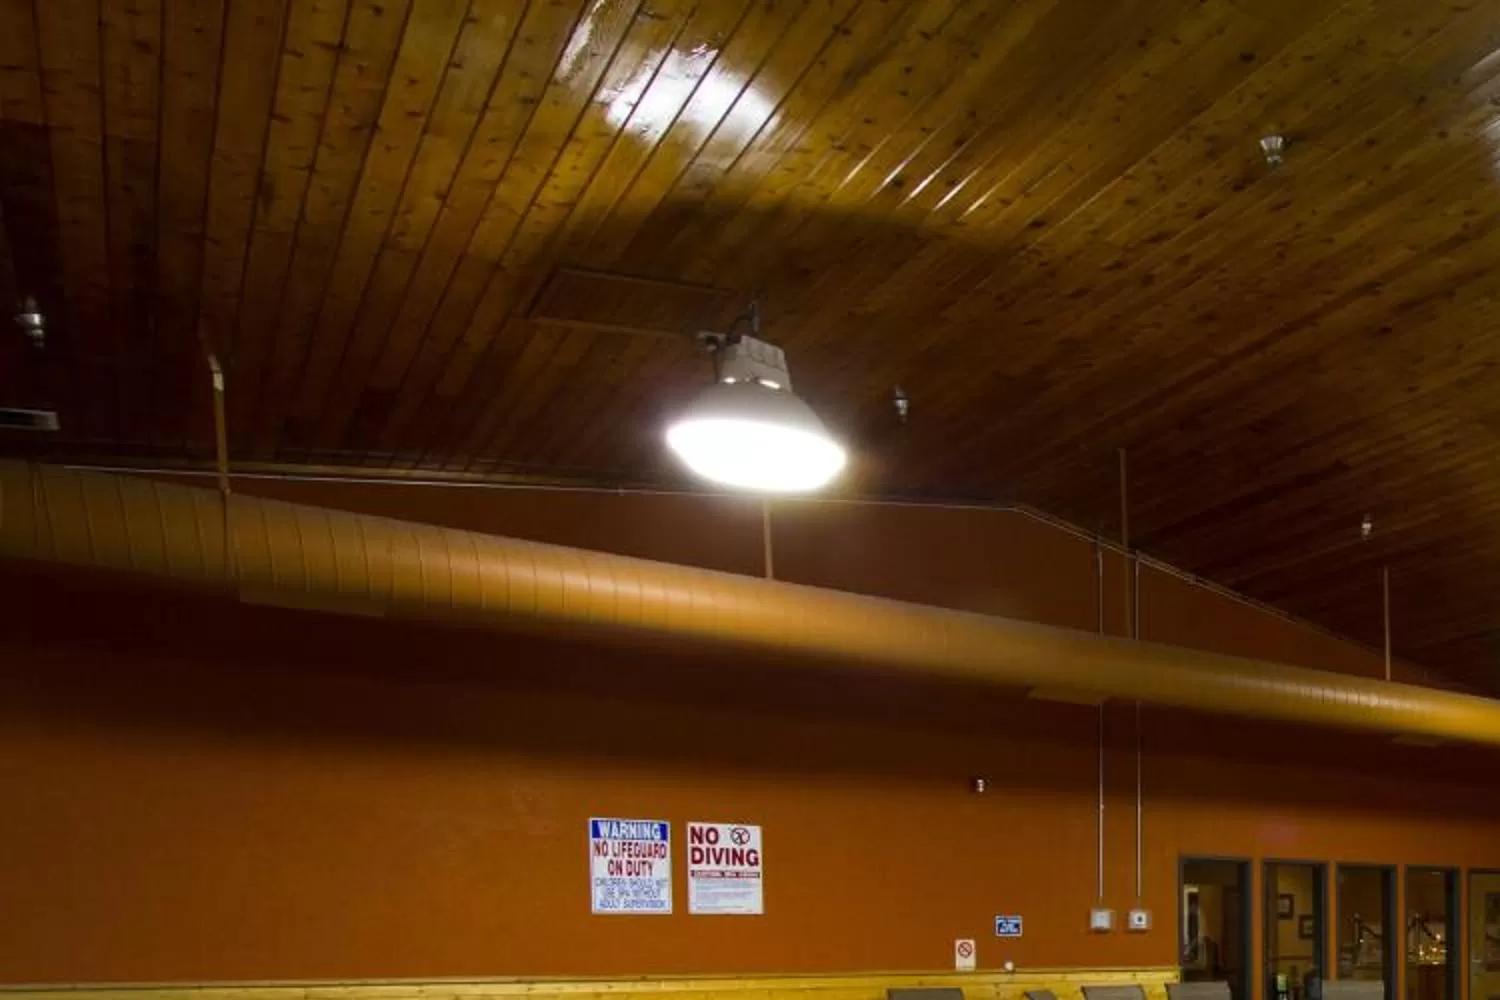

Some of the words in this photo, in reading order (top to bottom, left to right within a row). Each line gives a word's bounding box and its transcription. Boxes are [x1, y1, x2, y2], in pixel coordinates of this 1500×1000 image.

[598, 821, 661, 840] WARNING
[690, 826, 719, 845] NO
[594, 841, 608, 857] NO
[612, 842, 667, 859] LIFEGUARD
[691, 847, 759, 866] DIVING
[608, 859, 623, 876] ON
[625, 860, 653, 877] DUTY
